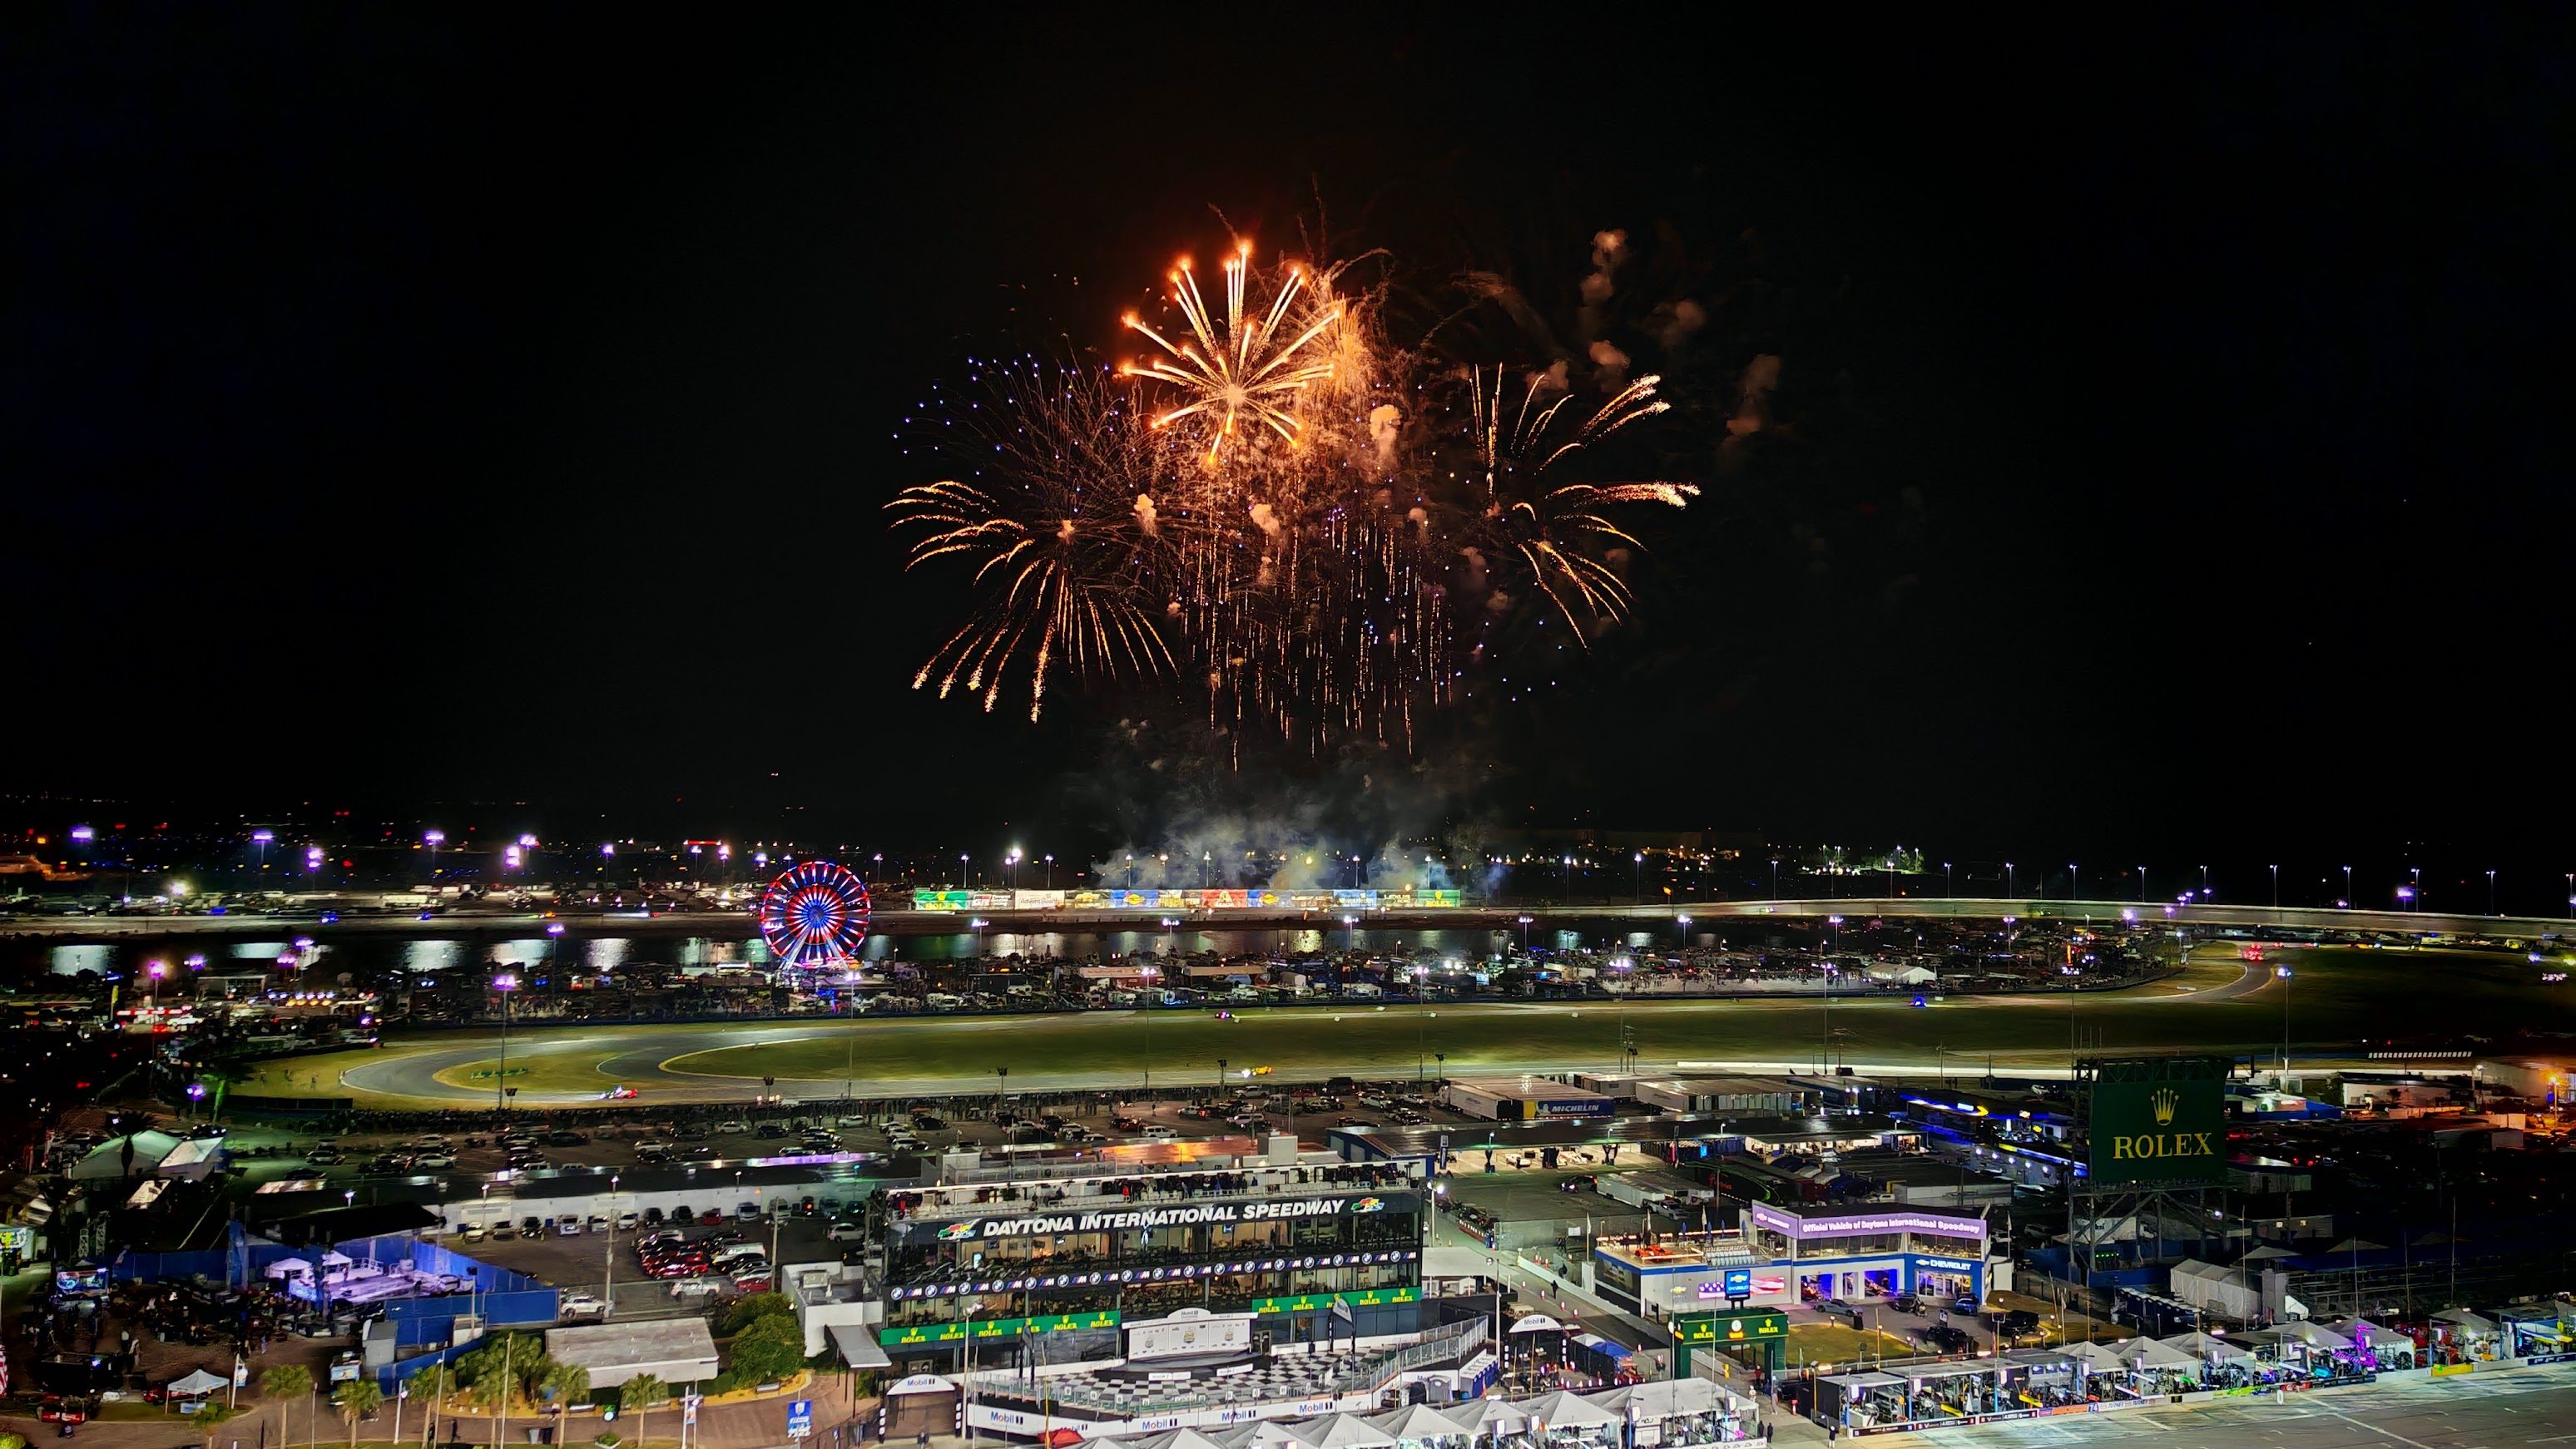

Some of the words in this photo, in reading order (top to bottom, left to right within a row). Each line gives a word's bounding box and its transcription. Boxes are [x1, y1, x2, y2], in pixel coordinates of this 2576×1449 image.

[1551, 1104, 1599, 1113] MICHELIN
[2113, 1132, 2214, 1160] ROLEX
[983, 1216, 1074, 1237] DAYTONA
[1079, 1204, 1237, 1230] INTERNATIONAL
[1242, 1199, 1345, 1219] SPEEDWAY
[1803, 1223, 1828, 1233] Official
[1829, 1222, 1852, 1231] Vehicle
[1853, 1221, 1860, 1229] of
[1861, 1220, 1888, 1229] Daytona
[1889, 1219, 1937, 1229] International
[1938, 1220, 1980, 1234] Speedway
[1930, 1259, 1971, 1270] CHEVROLET
[901, 1335, 925, 1343] ROLEX
[940, 1332, 964, 1340] ROLEX
[978, 1329, 1003, 1338] ROLEX
[1054, 1323, 1077, 1331] ROLEX
[1694, 1331, 1714, 1339] ROLEX
[1759, 1326, 1778, 1334] ROLEX
[1299, 1402, 1324, 1412] Mobil
[990, 1411, 1014, 1423] Mobil
[1221, 1411, 1246, 1422] Mobil
[1142, 1420, 1167, 1430] Mobil
